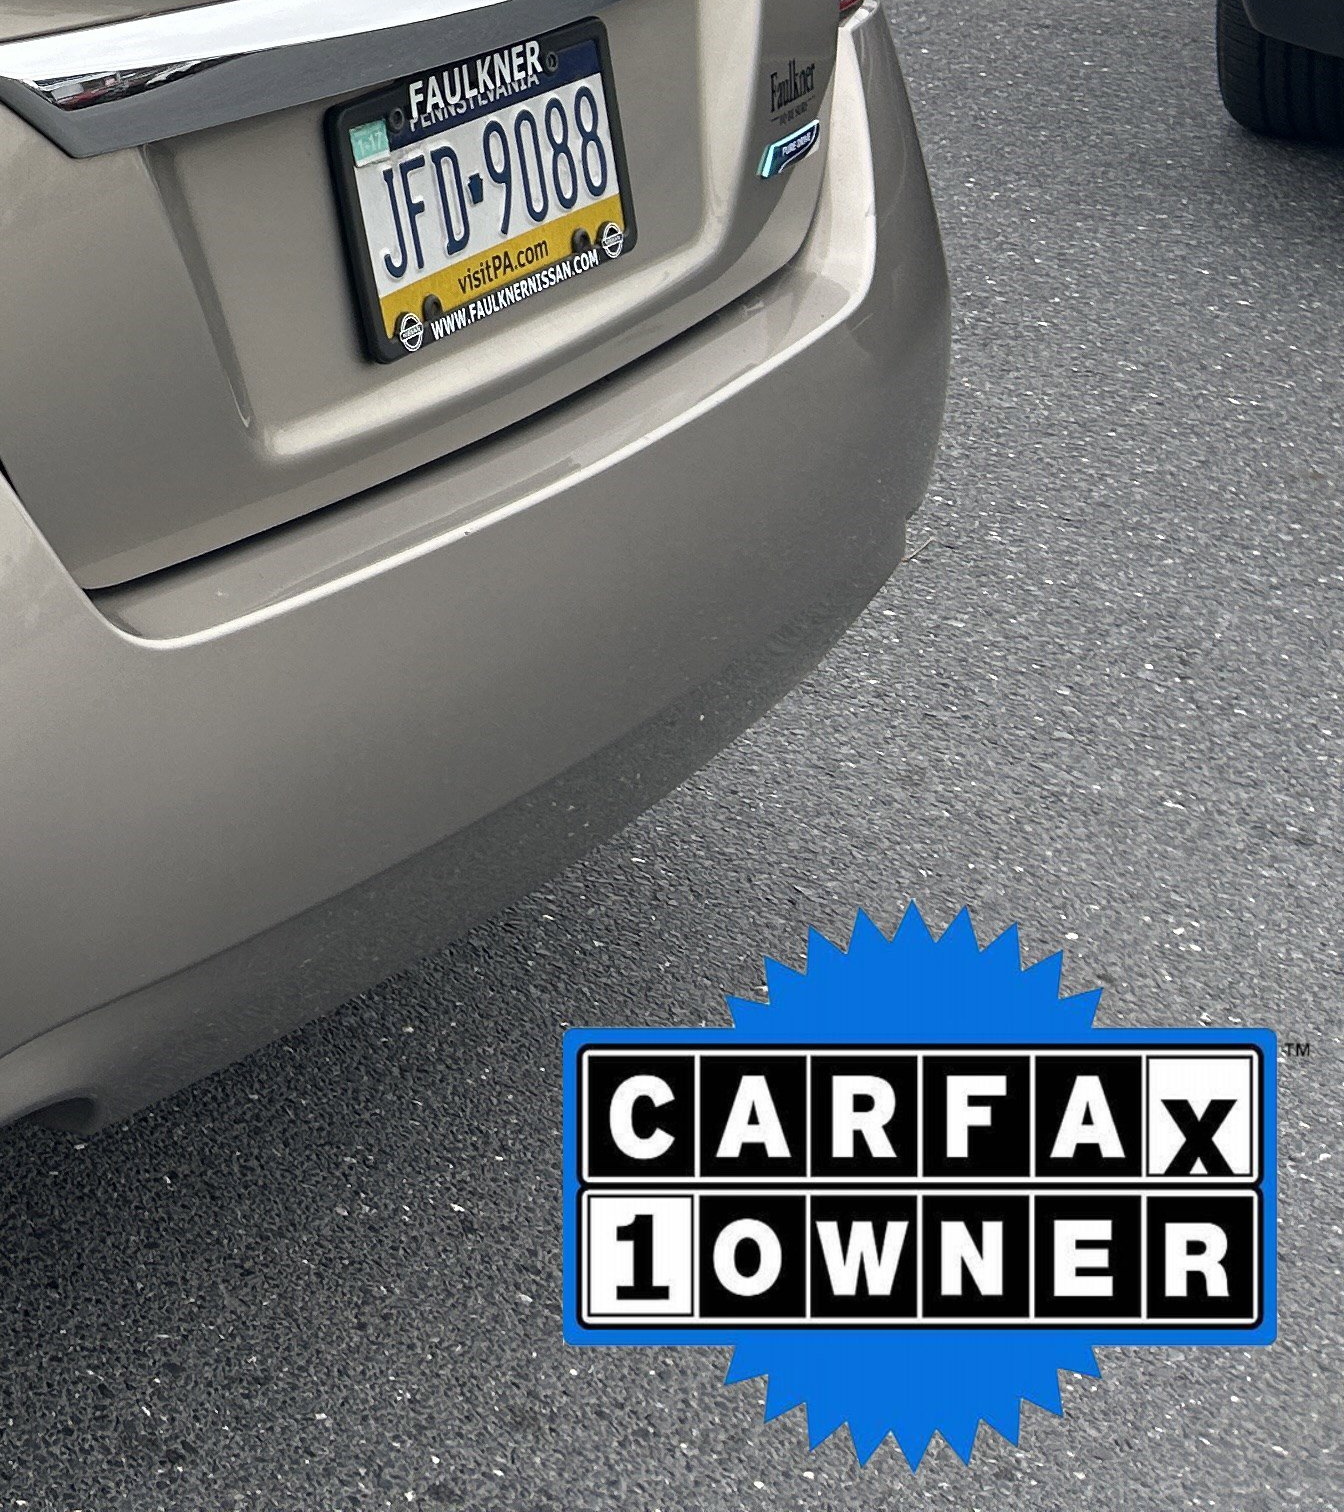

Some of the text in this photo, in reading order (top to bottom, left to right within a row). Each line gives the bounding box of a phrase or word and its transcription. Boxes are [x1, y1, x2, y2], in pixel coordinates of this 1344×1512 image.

[409, 40, 543, 120] FAULKNER
[771, 57, 815, 113] Faulkner
[384, 85, 607, 278] JFD 9088
[430, 249, 599, 340] WWW.FAULKNERNISSAN.COM
[458, 239, 549, 295] visitPA.com
